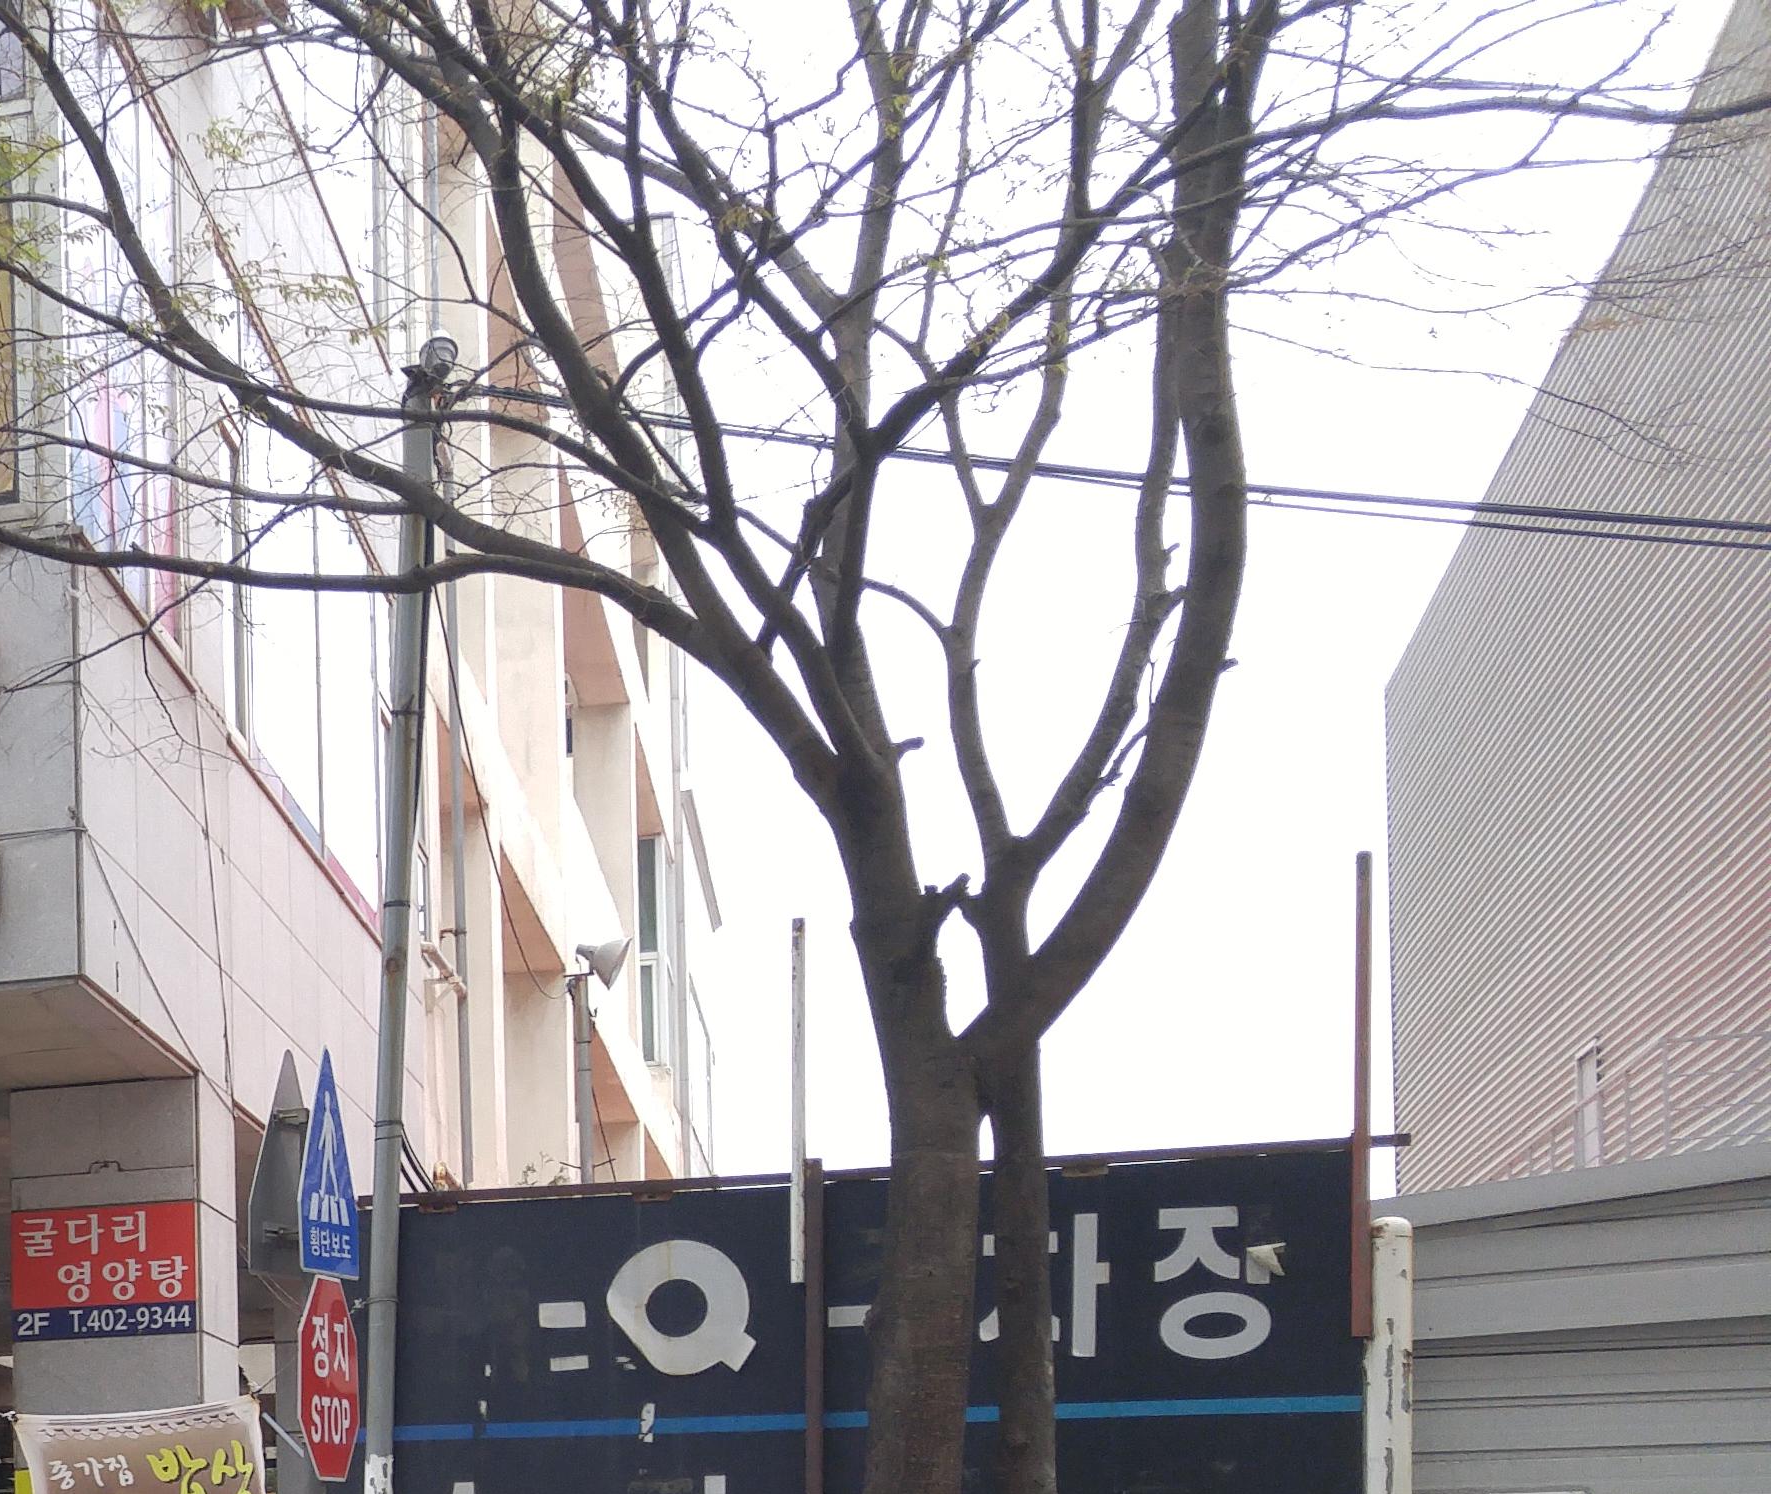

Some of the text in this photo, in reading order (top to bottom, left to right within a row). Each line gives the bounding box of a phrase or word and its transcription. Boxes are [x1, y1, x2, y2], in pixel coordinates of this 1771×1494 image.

[18, 1211, 147, 1258] 굴다리
[310, 1226, 352, 1260] 횡단보도
[56, 1255, 189, 1303] 영양탕
[17, 1304, 192, 1337] 2F T.402-9344
[311, 1312, 350, 1382] 정지
[310, 1396, 351, 1445] STOP
[48, 1453, 135, 1491] 종가집
